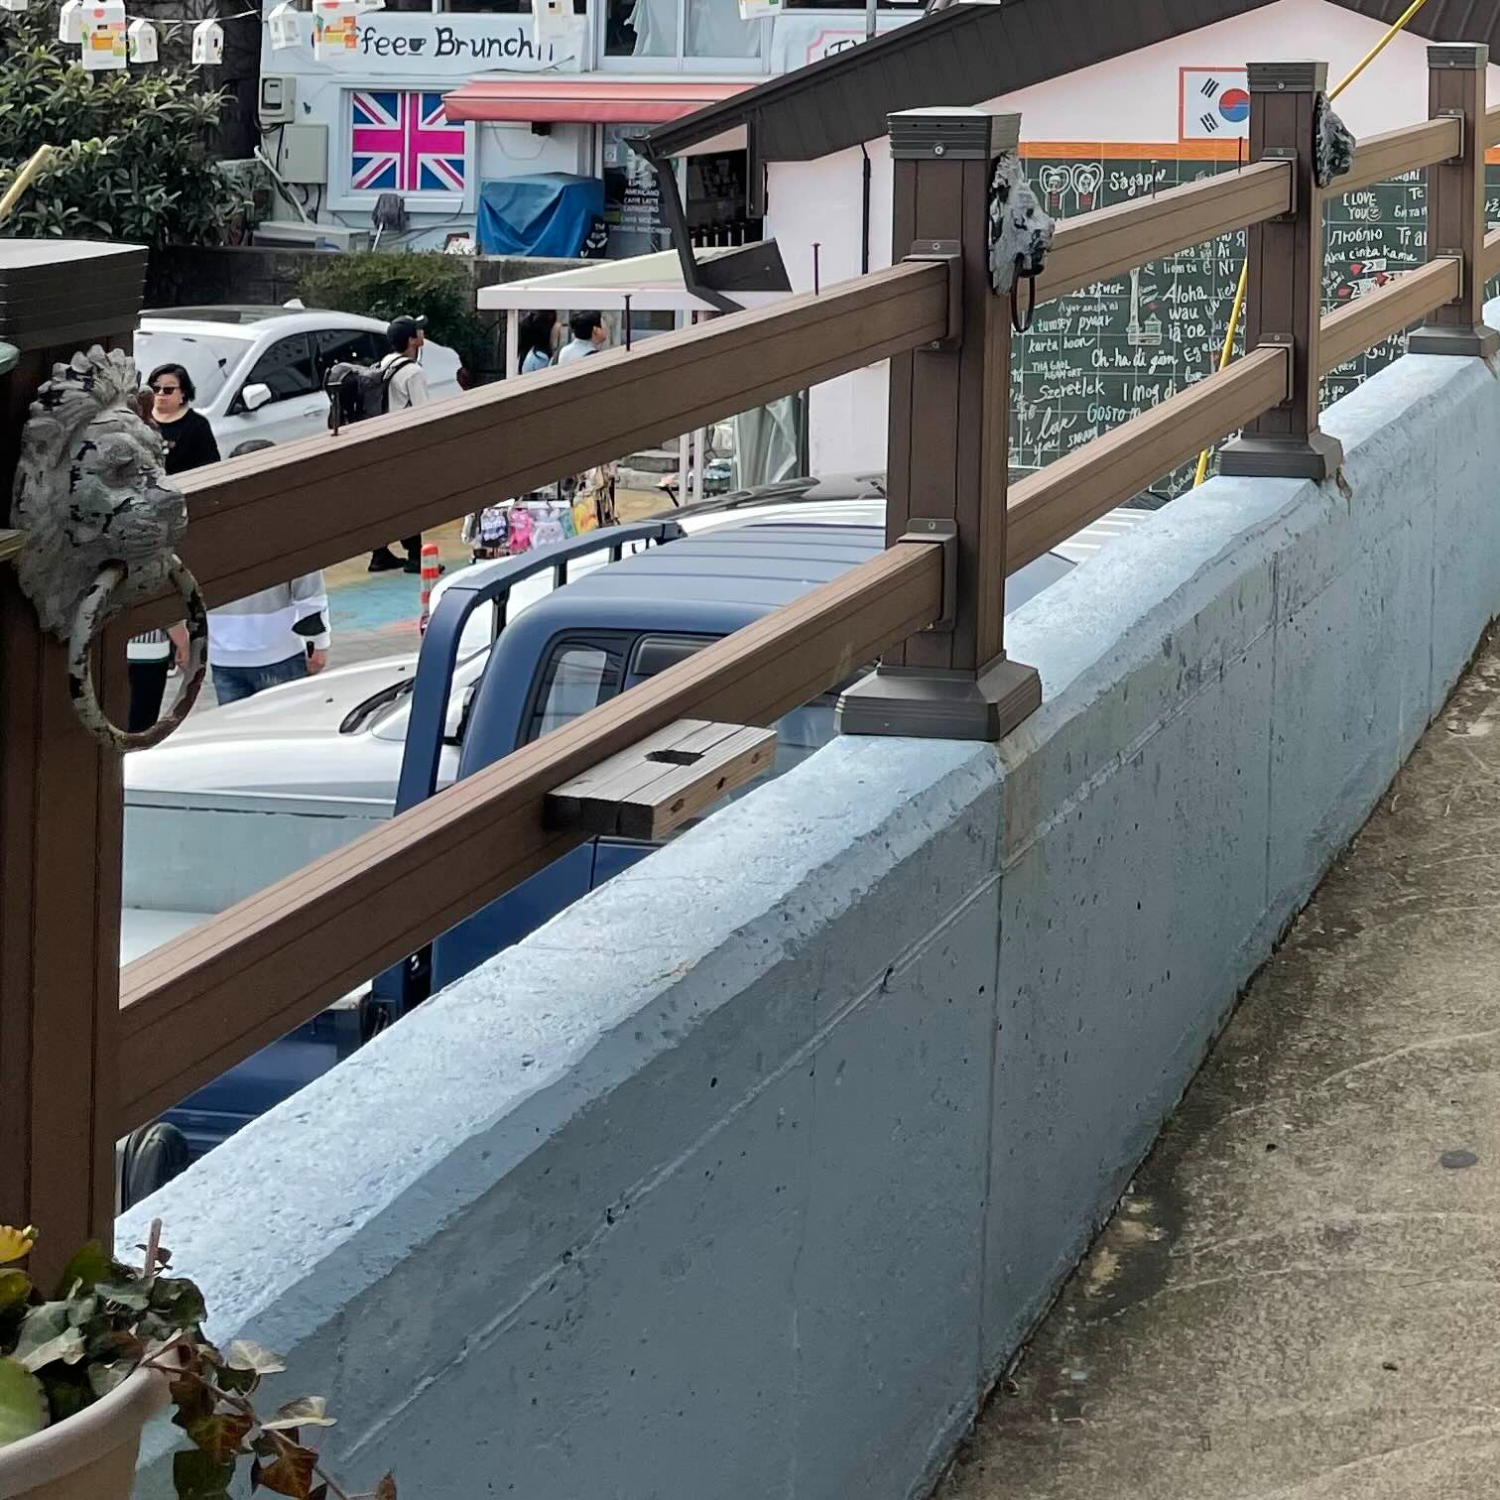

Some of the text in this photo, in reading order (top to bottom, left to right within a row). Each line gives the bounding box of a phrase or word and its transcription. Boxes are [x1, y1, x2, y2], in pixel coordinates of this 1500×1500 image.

[1351, 191, 1376, 206] LOVE
[1348, 206, 1367, 220] YOU
[1329, 227, 1383, 247] Люблю
[1162, 283, 1208, 304] Aloha
[1168, 306, 1199, 321] wau
[1033, 376, 1106, 403] Szeretlek
